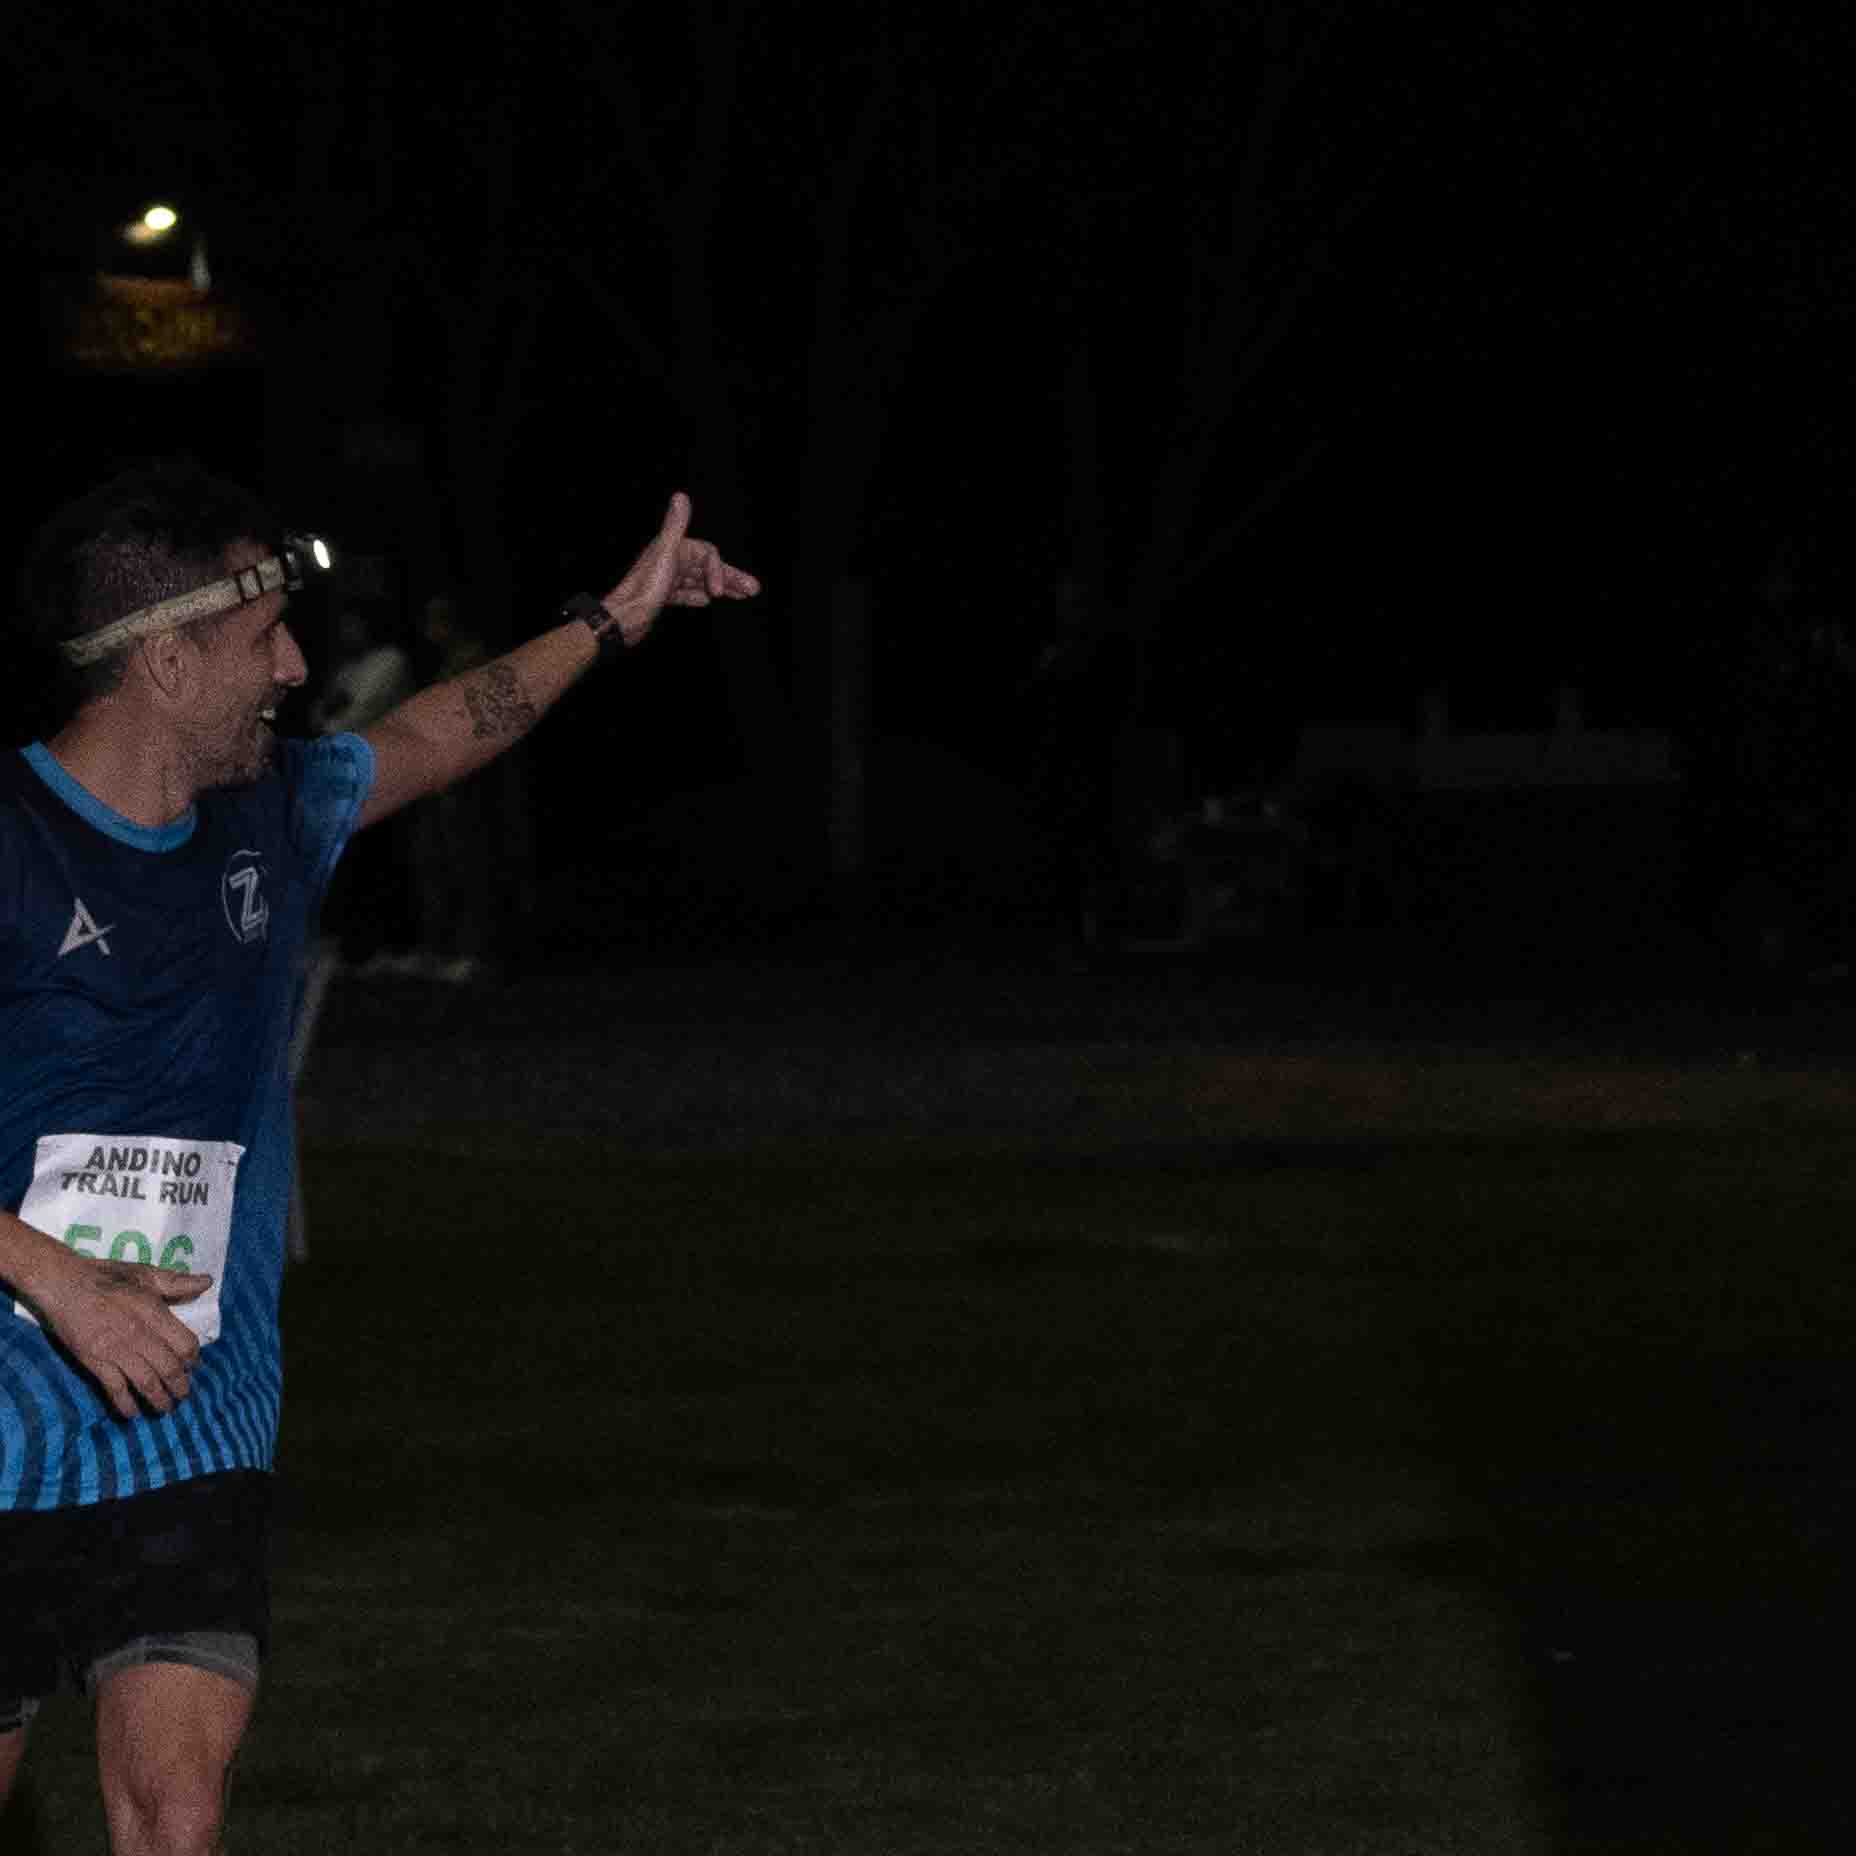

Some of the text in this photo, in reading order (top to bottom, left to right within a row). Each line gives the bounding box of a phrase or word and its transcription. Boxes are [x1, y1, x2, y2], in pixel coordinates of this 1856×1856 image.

[85, 1146, 201, 1177] ANDINO
[61, 1171, 209, 1205] TRAIL RUN
